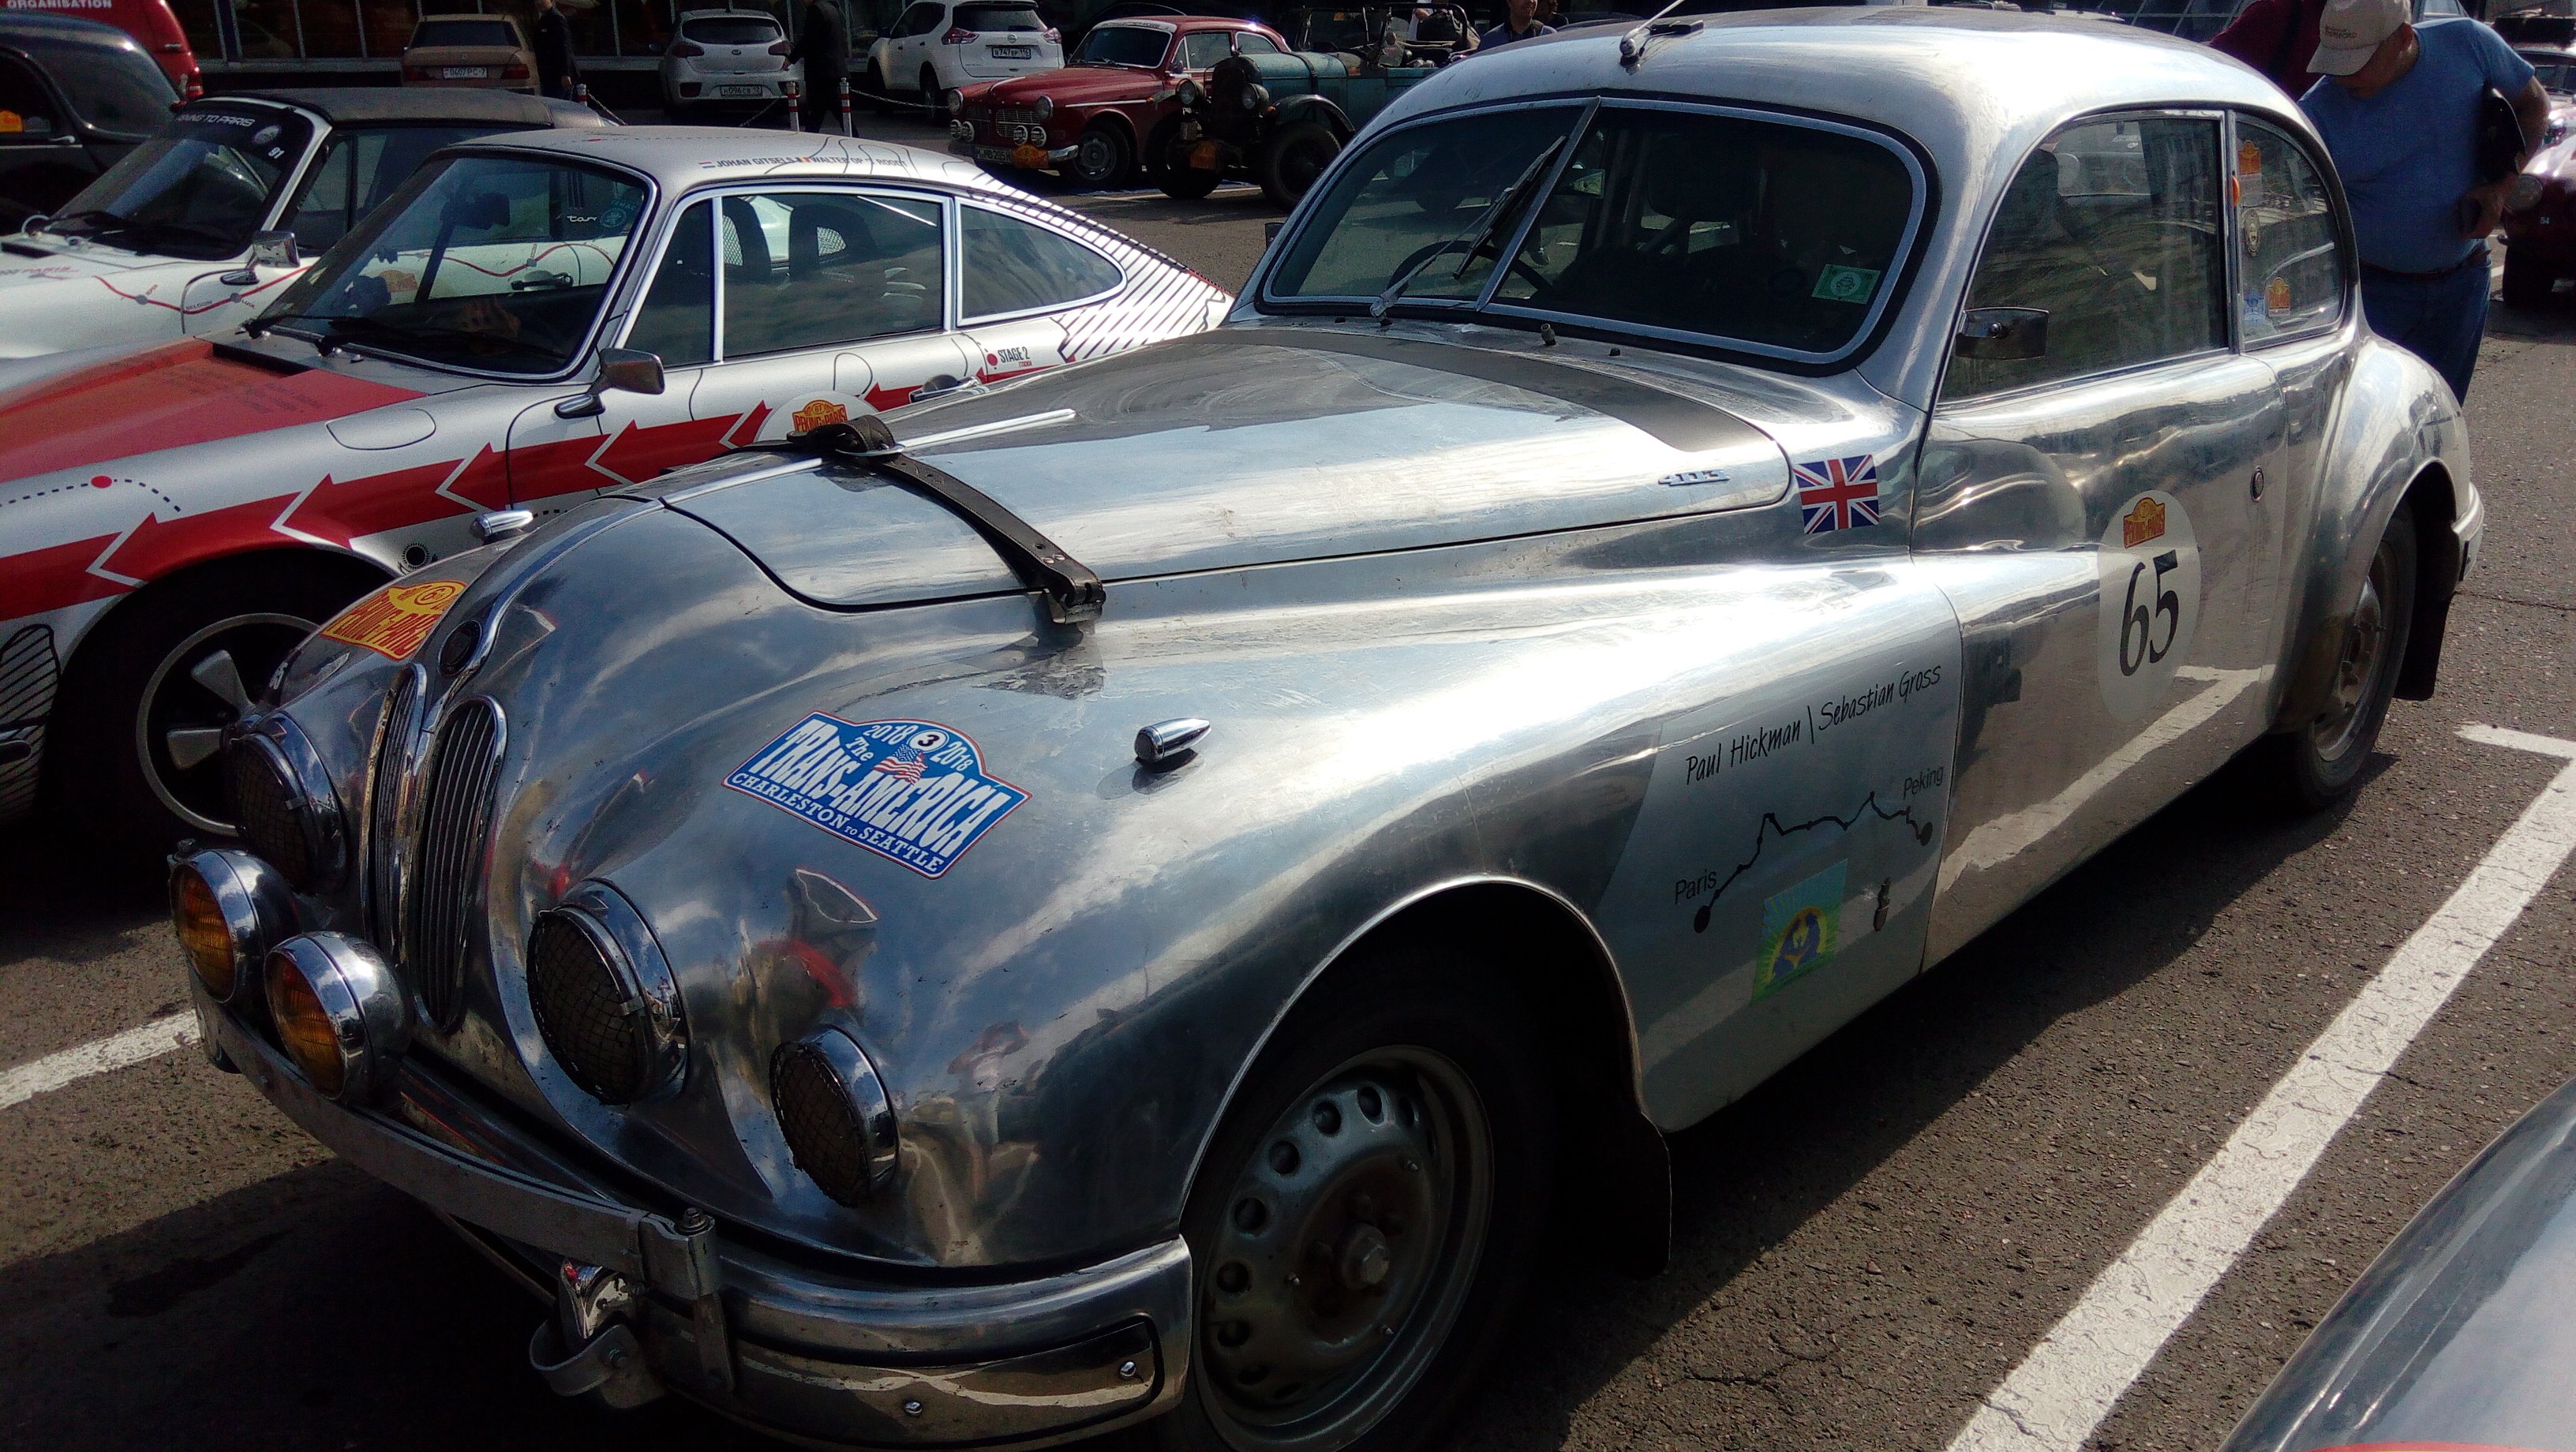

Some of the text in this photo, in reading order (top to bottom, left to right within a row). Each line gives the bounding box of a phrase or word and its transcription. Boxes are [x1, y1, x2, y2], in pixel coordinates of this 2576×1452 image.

[216, 116, 255, 127] PARIS
[716, 156, 795, 167] JOHAN GITSELS
[998, 346, 1030, 363] STAGE 2
[2120, 549, 2179, 676] 65
[1685, 743, 1723, 784] Paul
[1730, 720, 1802, 768] Hickman
[1818, 683, 1895, 732] Sebastian
[1899, 665, 1941, 704] Gross
[844, 736, 875, 762] The
[862, 724, 974, 773] 2018 3 2018
[748, 719, 1013, 859] TRANS-AMERICA
[1904, 765, 1944, 799] Peking
[731, 773, 945, 873] CHARLESTON TO SEATTLE
[1675, 869, 1717, 904] Paris
